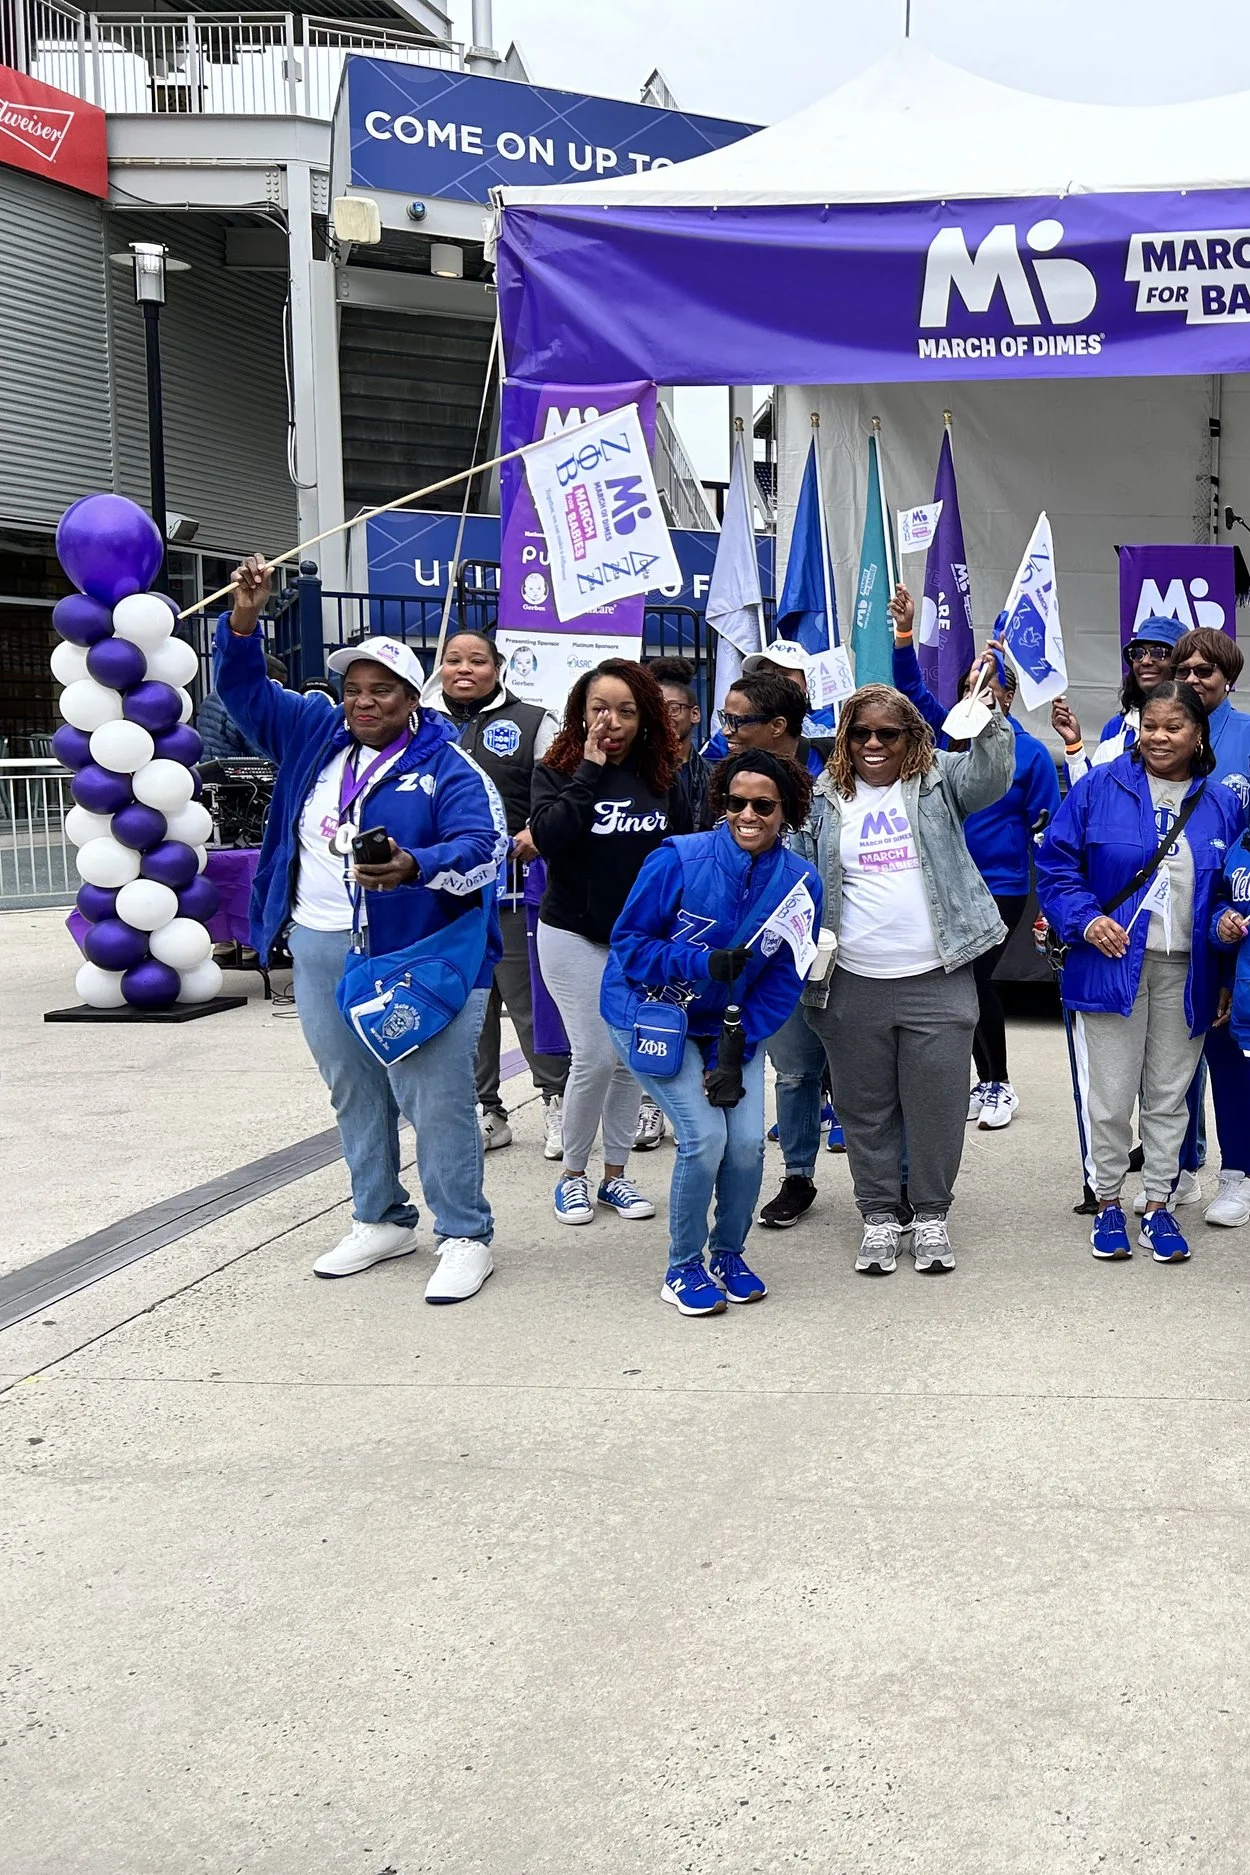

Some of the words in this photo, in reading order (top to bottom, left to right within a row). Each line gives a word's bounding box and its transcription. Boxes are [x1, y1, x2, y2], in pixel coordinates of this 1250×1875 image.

[365, 110, 484, 155] COME
[496, 132, 554, 167] ON
[568, 142, 618, 174] UP
[1146, 286, 1189, 304] FOR
[918, 337, 996, 358] MARCH
[1000, 336, 1028, 357] OF
[1031, 335, 1101, 356] DIMES
[566, 495, 575, 511] FOR
[593, 481, 605, 509] MARCH
[573, 488, 596, 538] MARCH
[567, 512, 585, 558] BABIES
[591, 799, 668, 835] Finer
[861, 849, 905, 864] MARCH
[881, 859, 920, 872] BABIES
